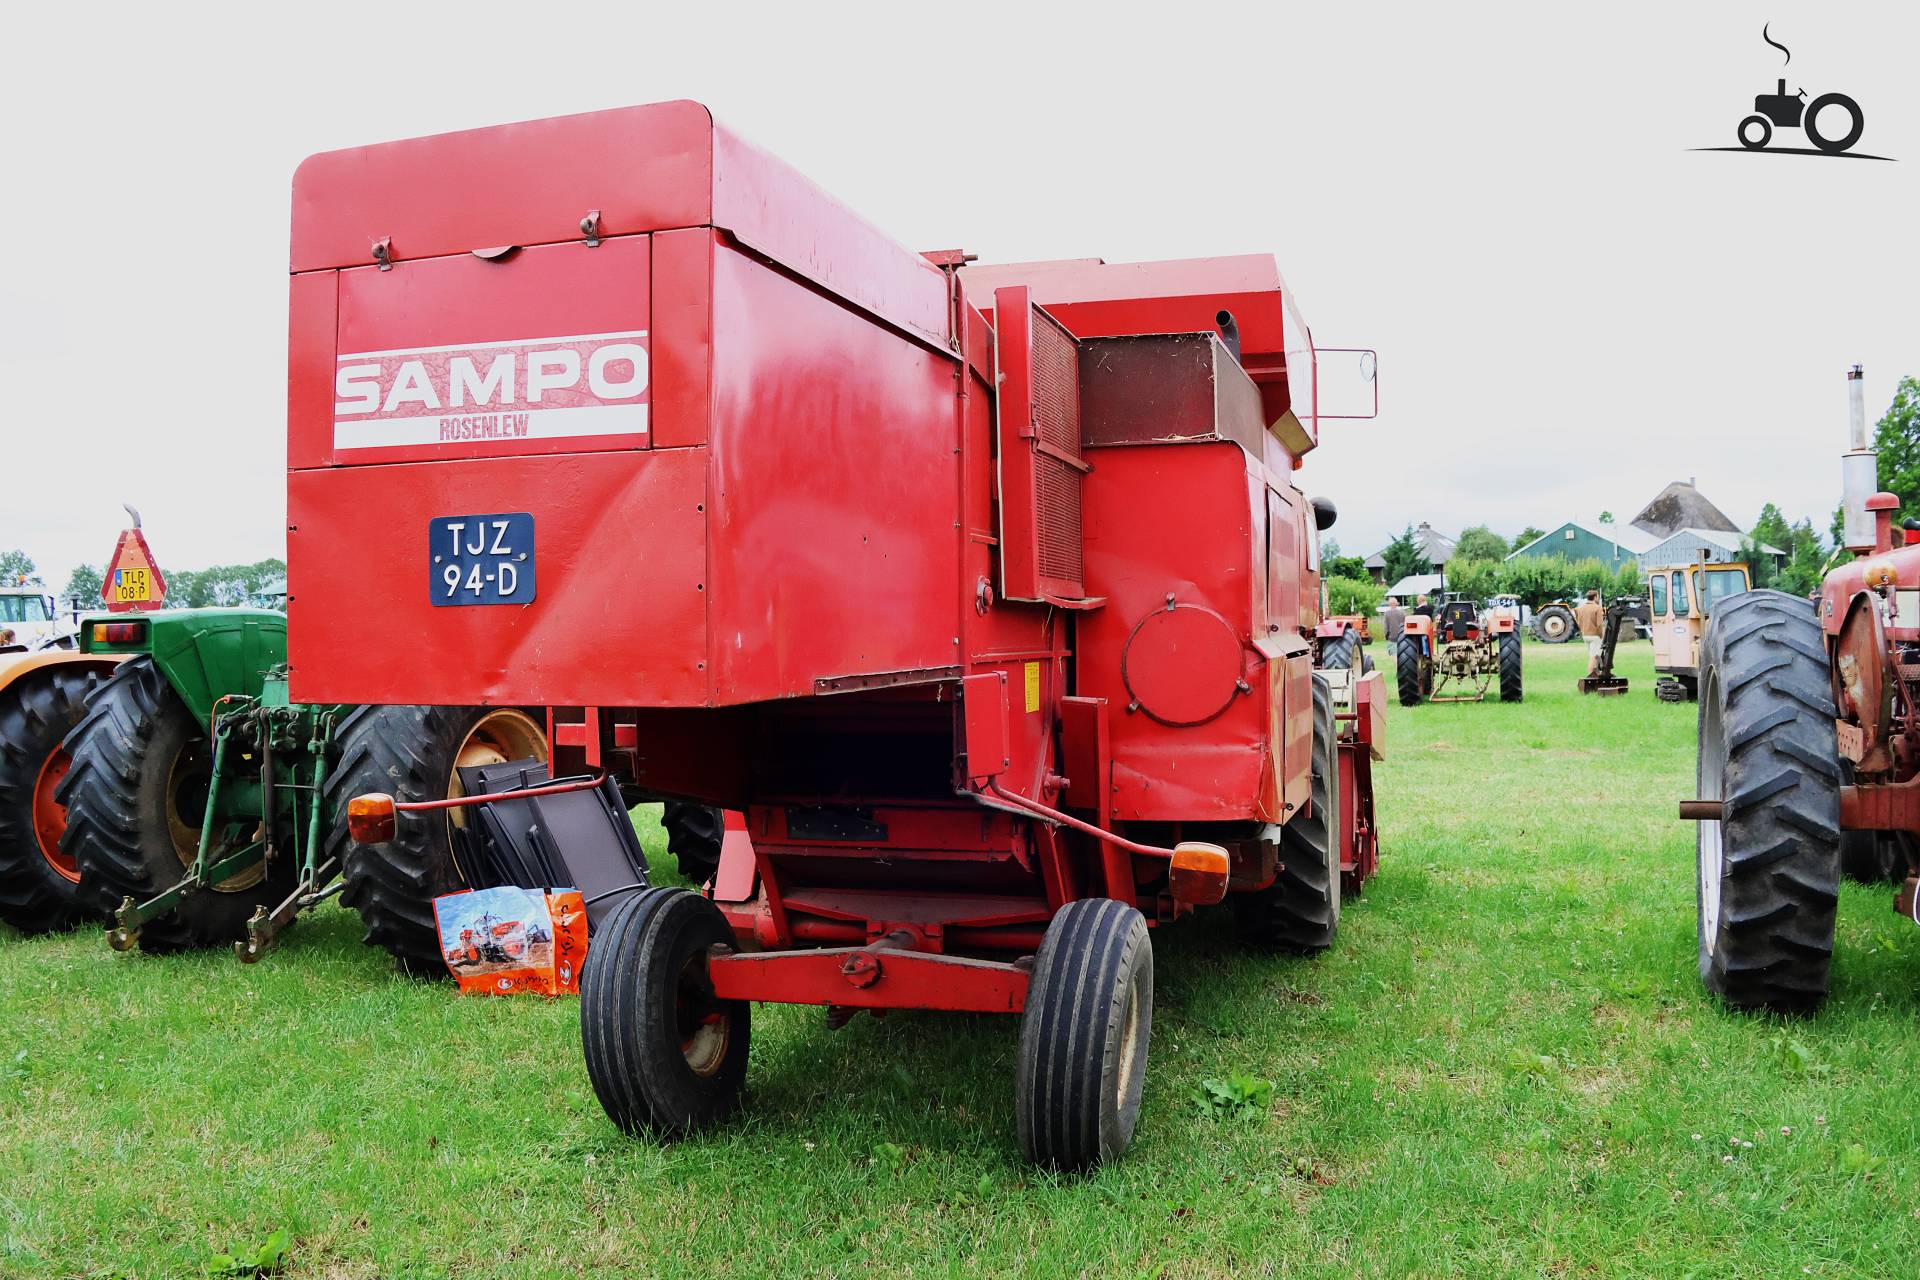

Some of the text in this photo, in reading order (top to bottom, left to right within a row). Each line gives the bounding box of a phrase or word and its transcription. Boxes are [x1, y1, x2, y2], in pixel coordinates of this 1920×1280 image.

[335, 343, 649, 416] SAMPO
[439, 413, 530, 441] ROSENLEW
[447, 520, 512, 556] TJZ
[121, 586, 146, 600] 08-P
[124, 570, 145, 584] TLP
[443, 562, 518, 598] 94-D
